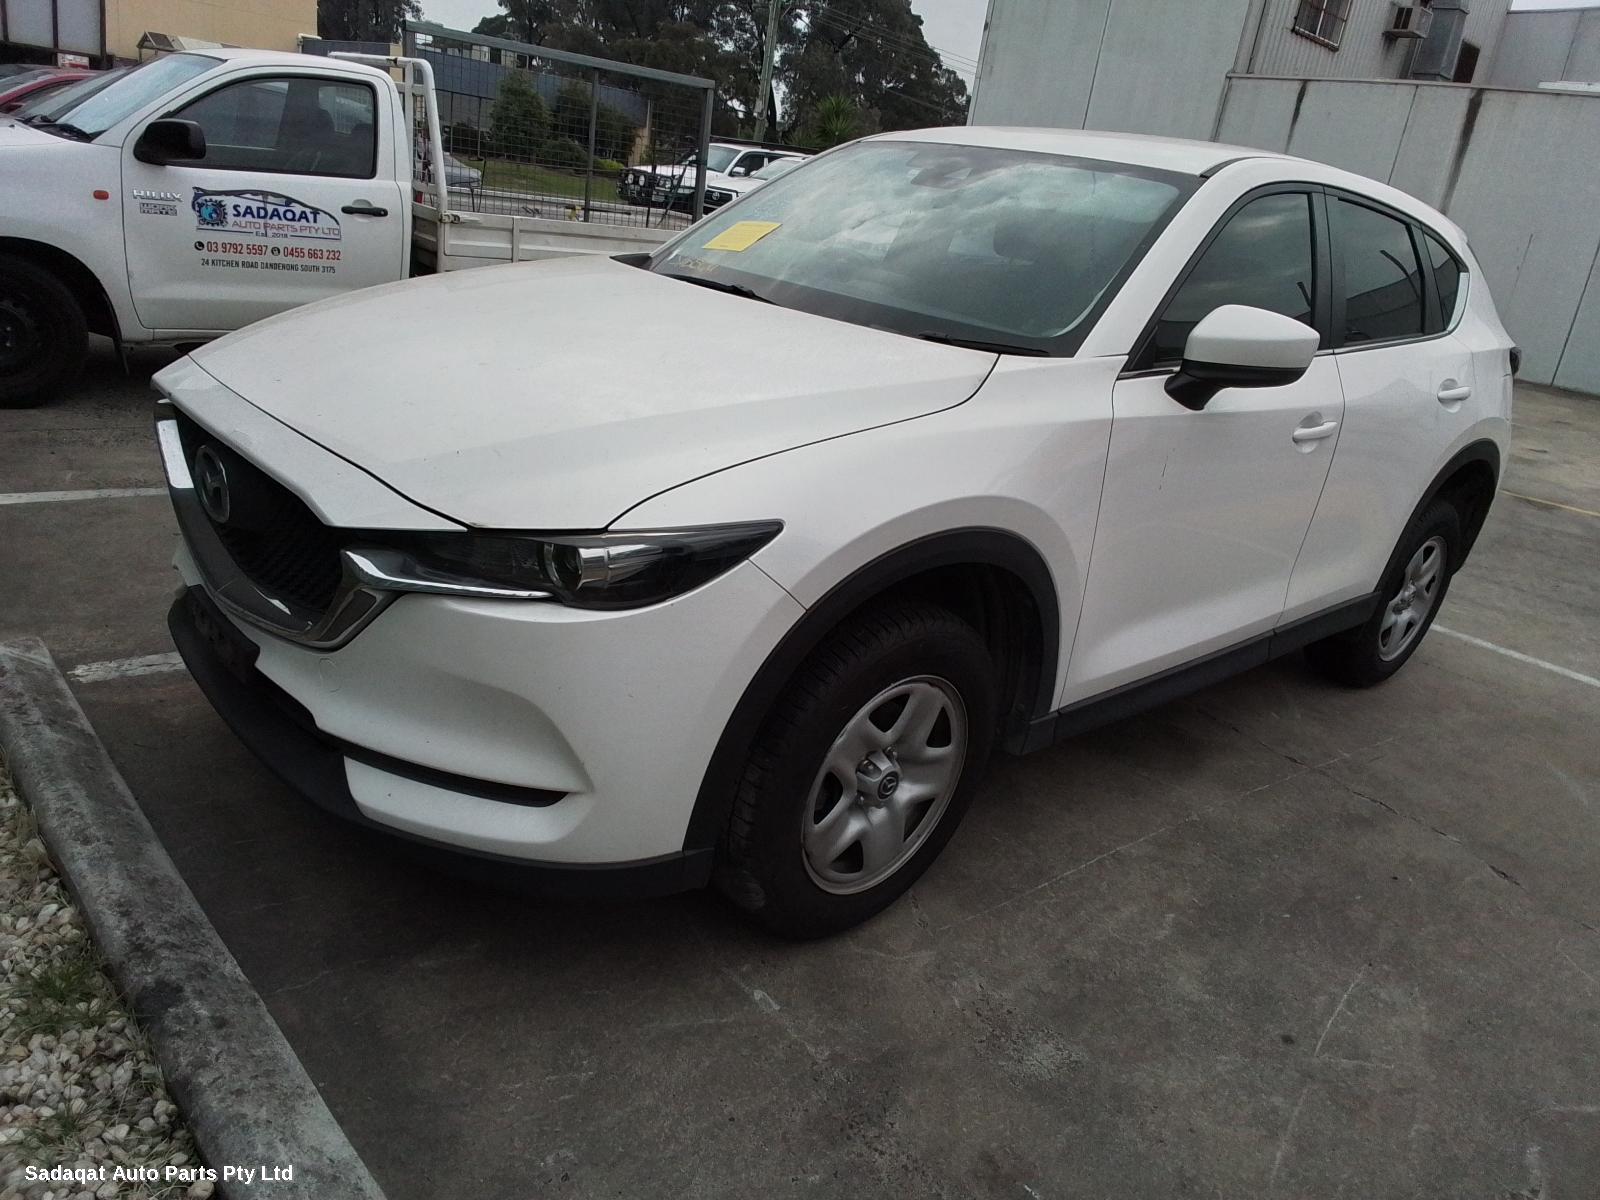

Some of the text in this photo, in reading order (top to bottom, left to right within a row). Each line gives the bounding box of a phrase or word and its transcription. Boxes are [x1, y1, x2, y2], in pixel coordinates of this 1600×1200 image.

[232, 204, 320, 224] SADAQAT
[232, 221, 340, 236] AUTO PARTS PTY LTD
[206, 241, 341, 260] 03 9792 5597 0455 663 232
[201, 258, 336, 274] 24 KITCHEN ROAD DANDENONG SOUTH 3175
